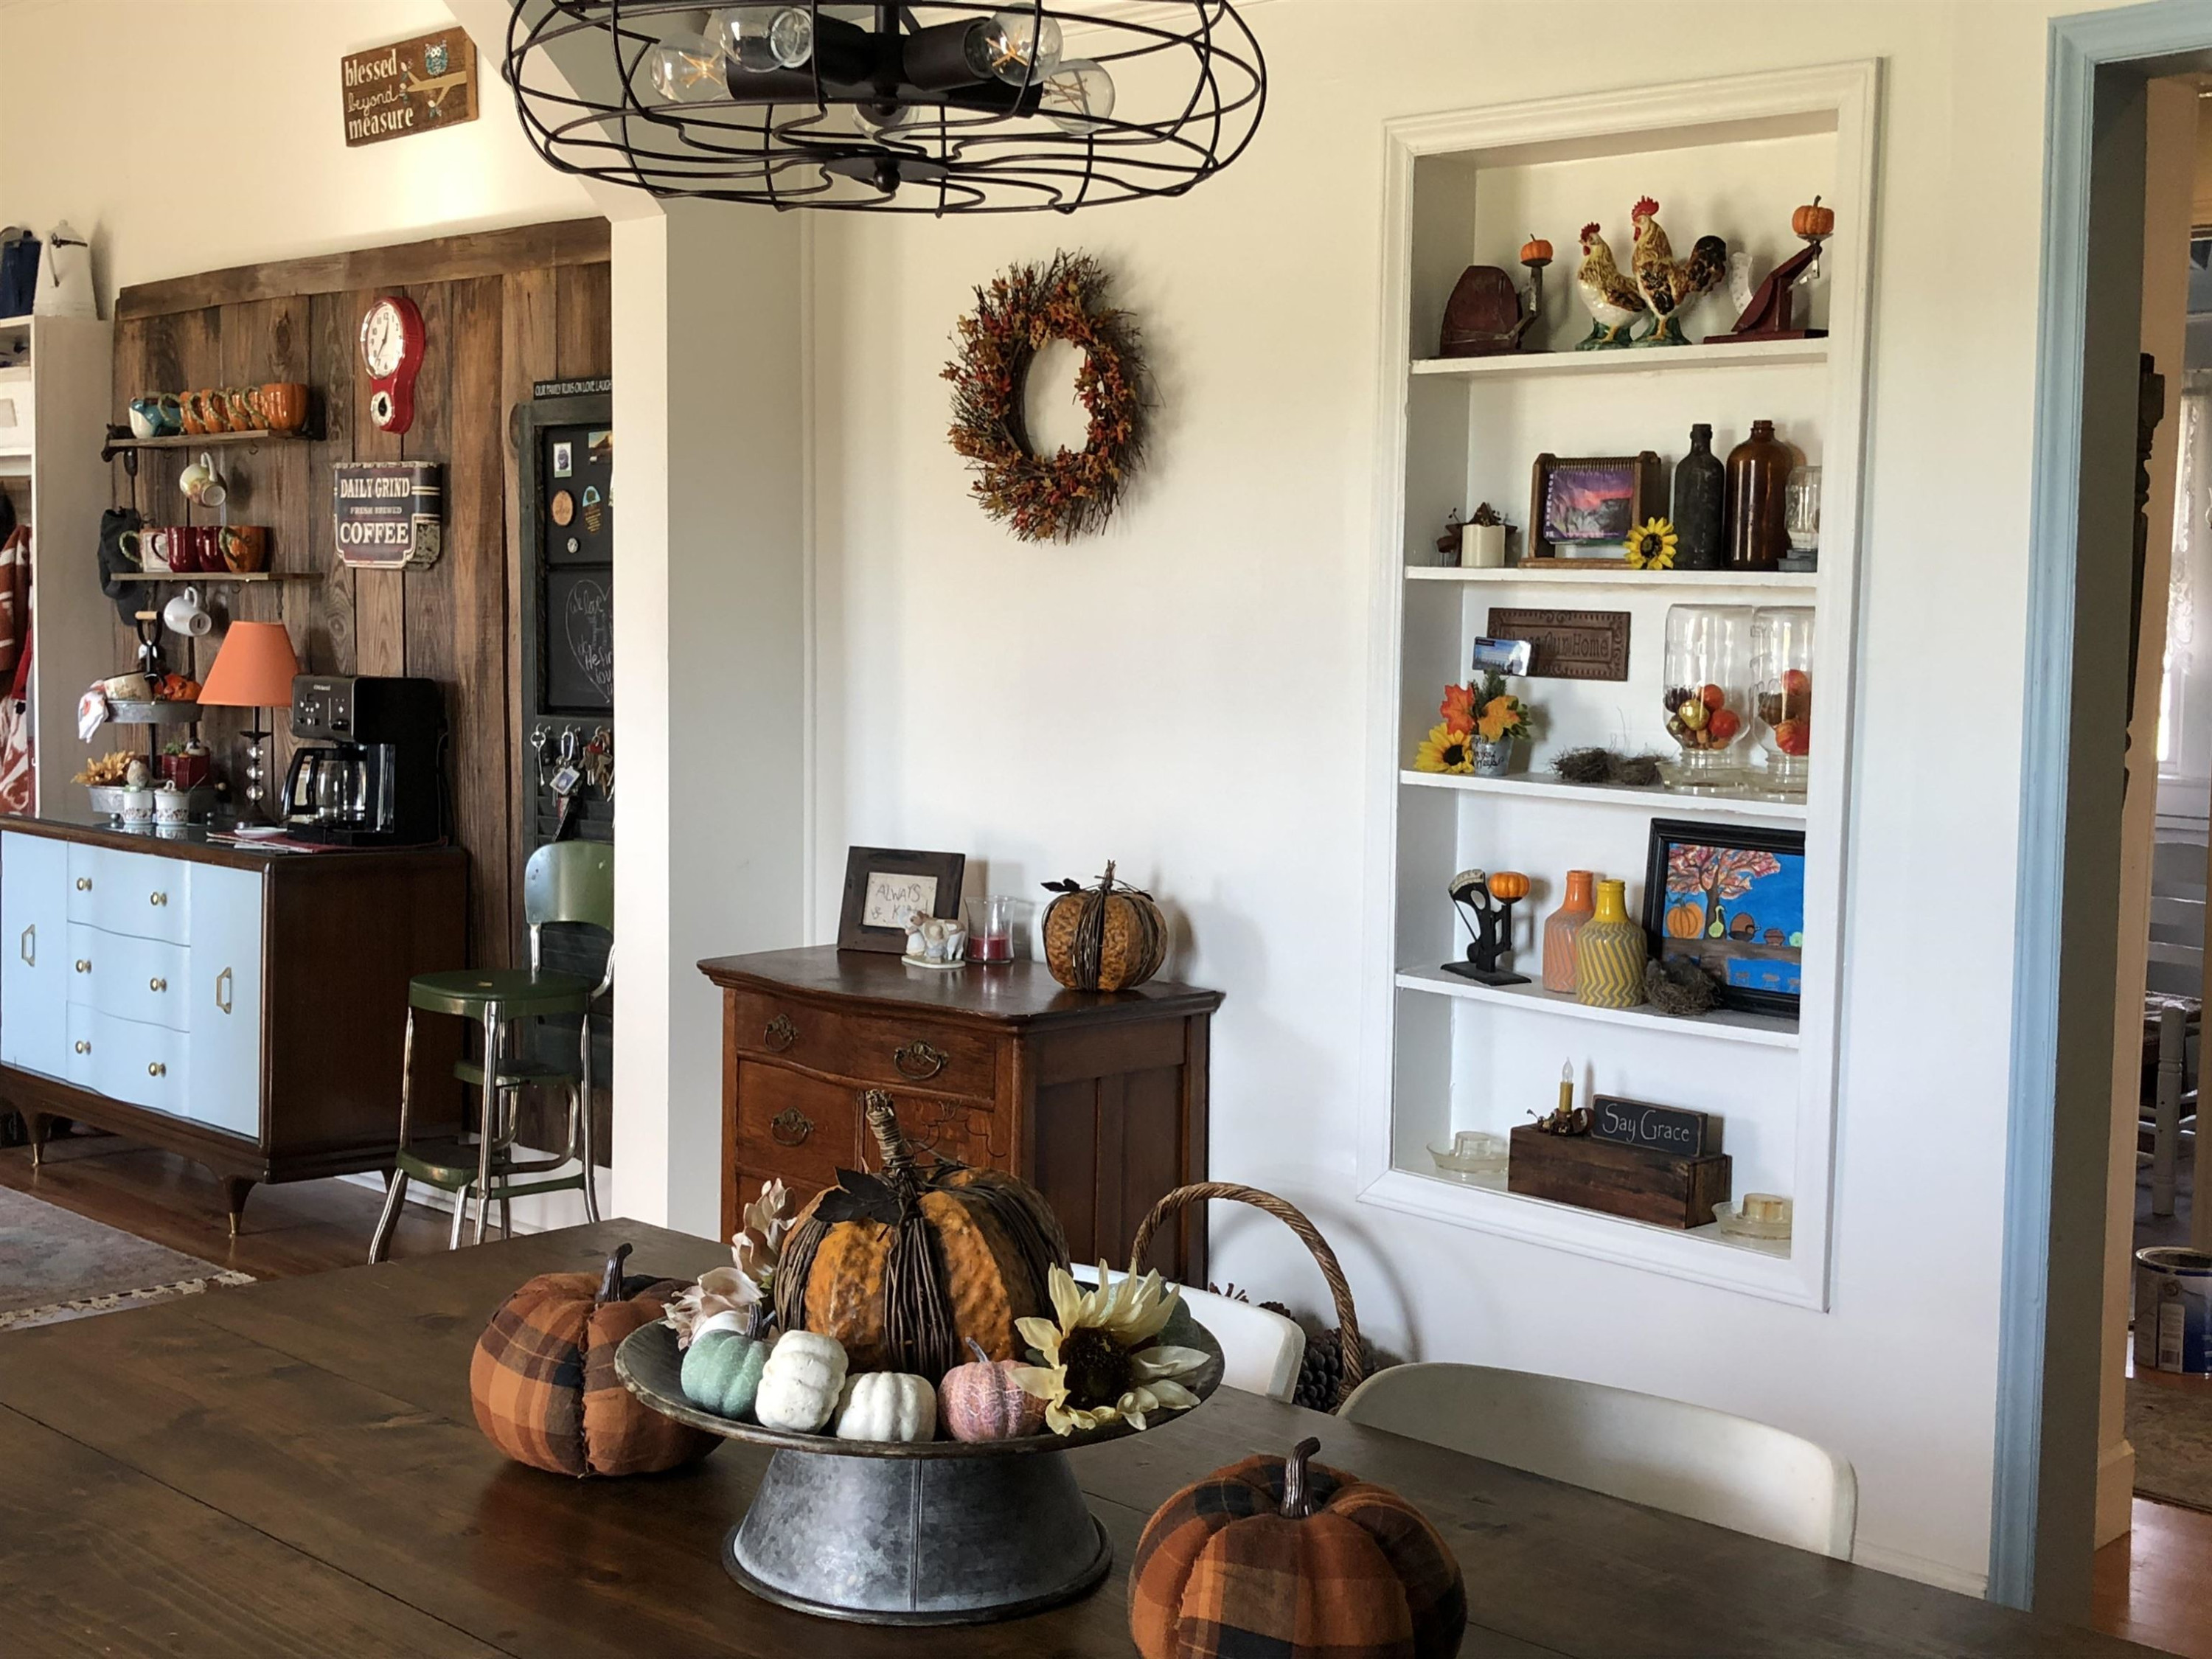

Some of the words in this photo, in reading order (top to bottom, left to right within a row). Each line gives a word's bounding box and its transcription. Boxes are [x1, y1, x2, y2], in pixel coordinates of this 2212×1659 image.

[344, 48, 398, 87] blessed
[347, 84, 400, 116] beyond
[348, 107, 414, 140] measure
[340, 478, 374, 498] DAILY
[375, 477, 411, 498] GRIND
[349, 507, 373, 515] FRESH
[375, 506, 403, 515] BREWED
[340, 521, 409, 544] COFFEE
[1572, 633, 1609, 658] Home
[876, 883, 922, 902] ALWAYS
[1602, 1103, 1636, 1143] Say
[1641, 1110, 1690, 1142] Grace
